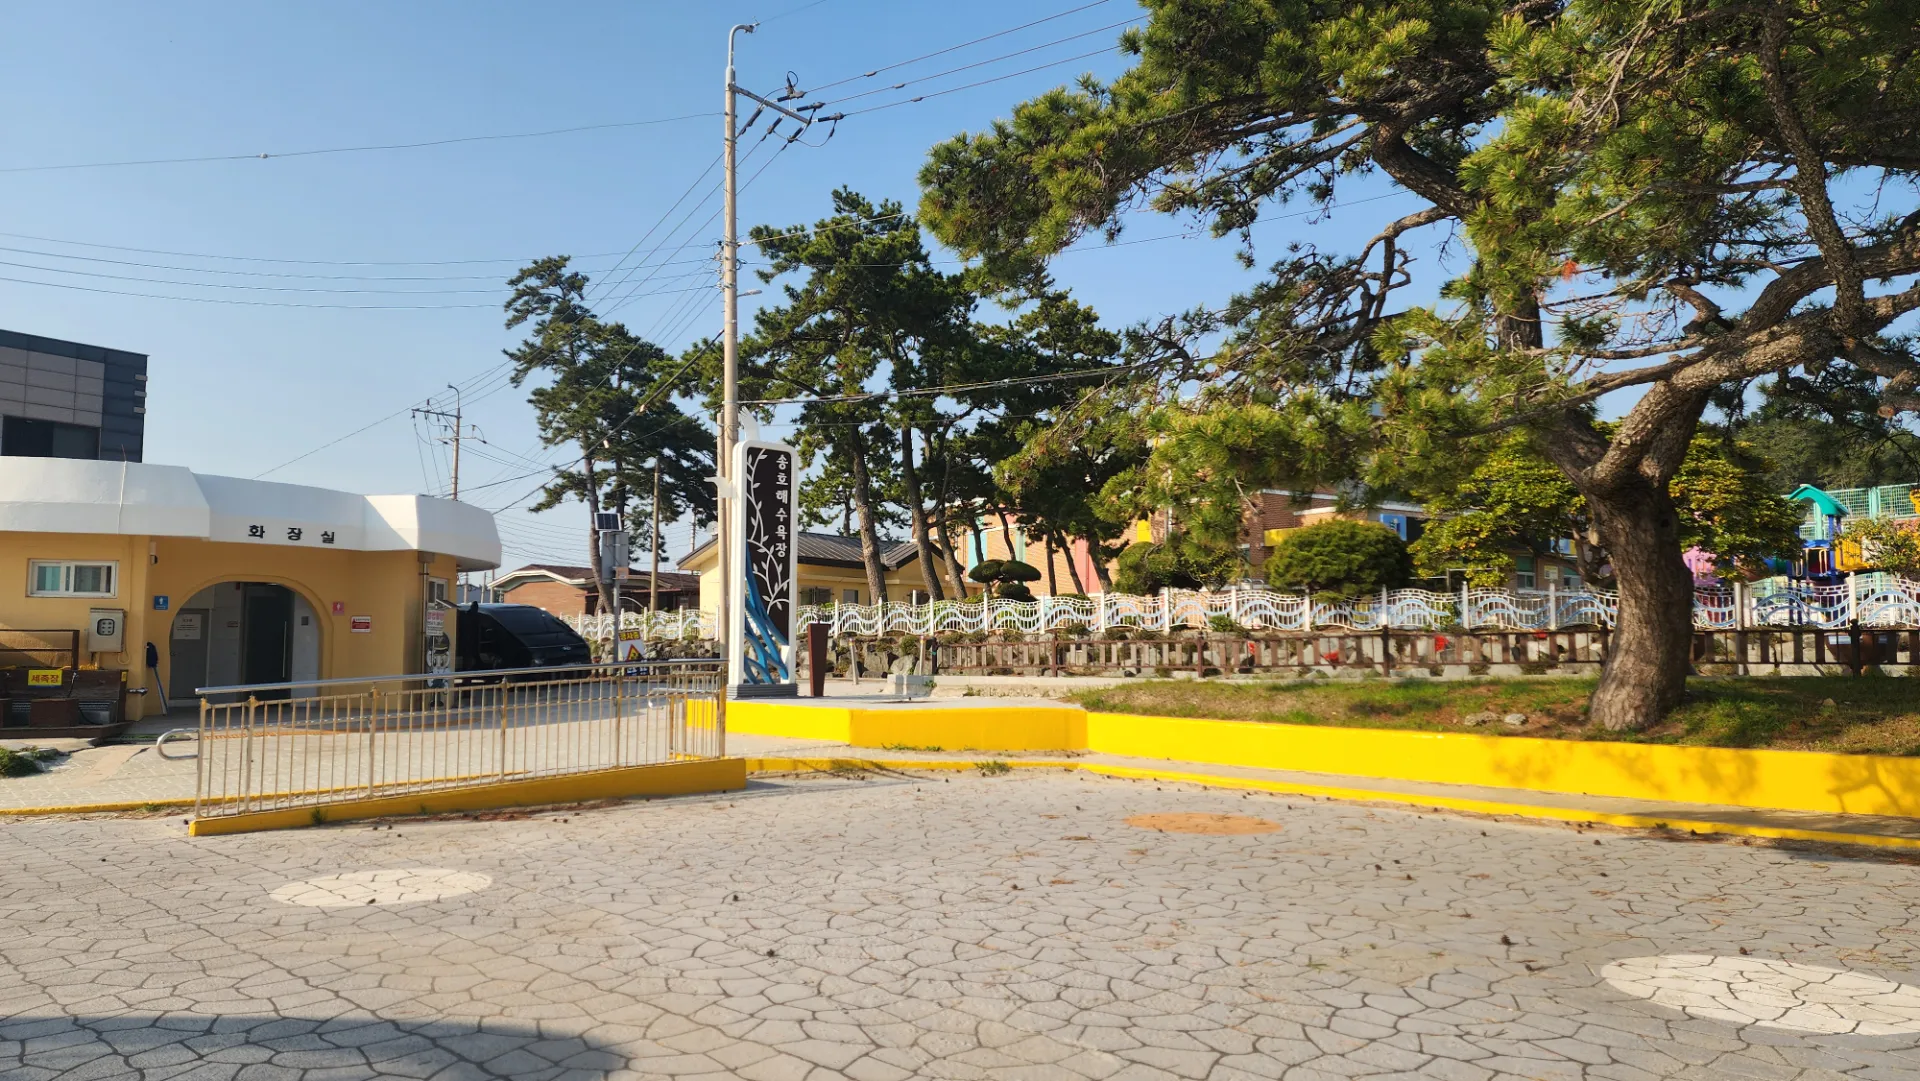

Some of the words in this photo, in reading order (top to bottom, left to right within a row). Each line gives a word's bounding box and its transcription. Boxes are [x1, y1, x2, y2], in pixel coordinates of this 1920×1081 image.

[775, 454, 788, 557] 송호해수욕장
[248, 525, 335, 544] 화장실
[31, 674, 59, 683] 세족장
